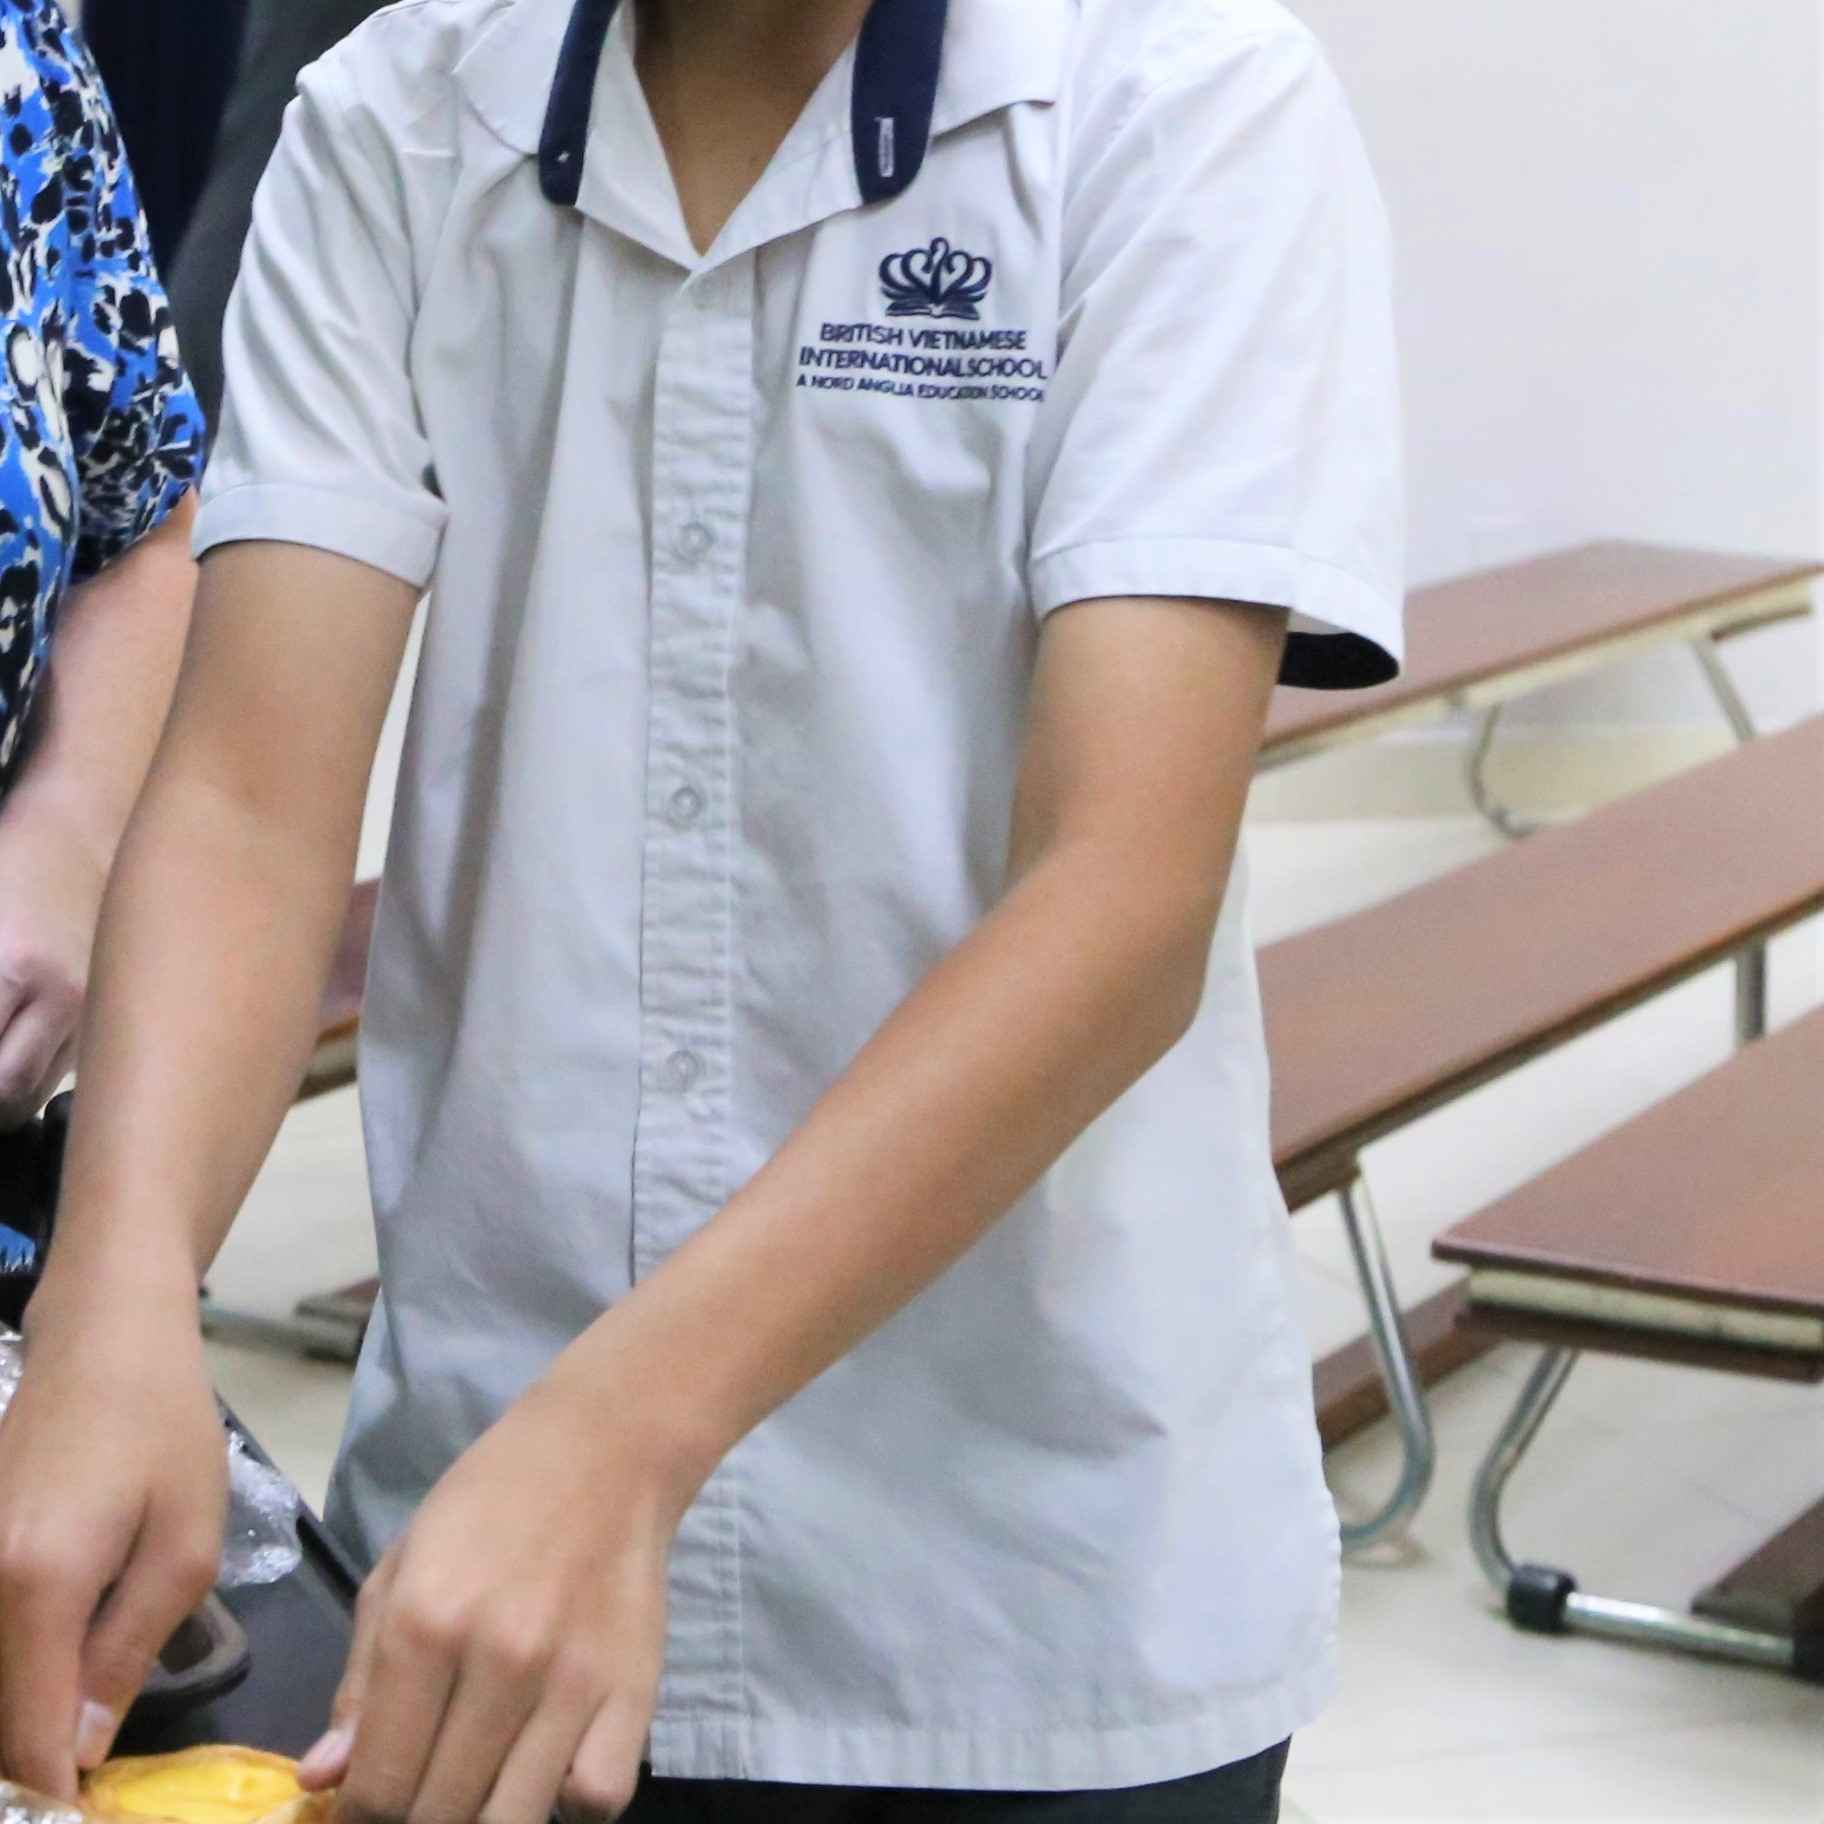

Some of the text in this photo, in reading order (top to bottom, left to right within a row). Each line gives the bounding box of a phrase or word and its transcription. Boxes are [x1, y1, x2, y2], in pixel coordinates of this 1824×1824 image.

[820, 323, 1027, 351] BRITISH VIETNAMESE
[799, 346, 1048, 379] INTERNATIONAL SCHOOL
[796, 374, 807, 387] A
[857, 377, 914, 397] ANGLIA
[990, 384, 1045, 402] SCHOOL
